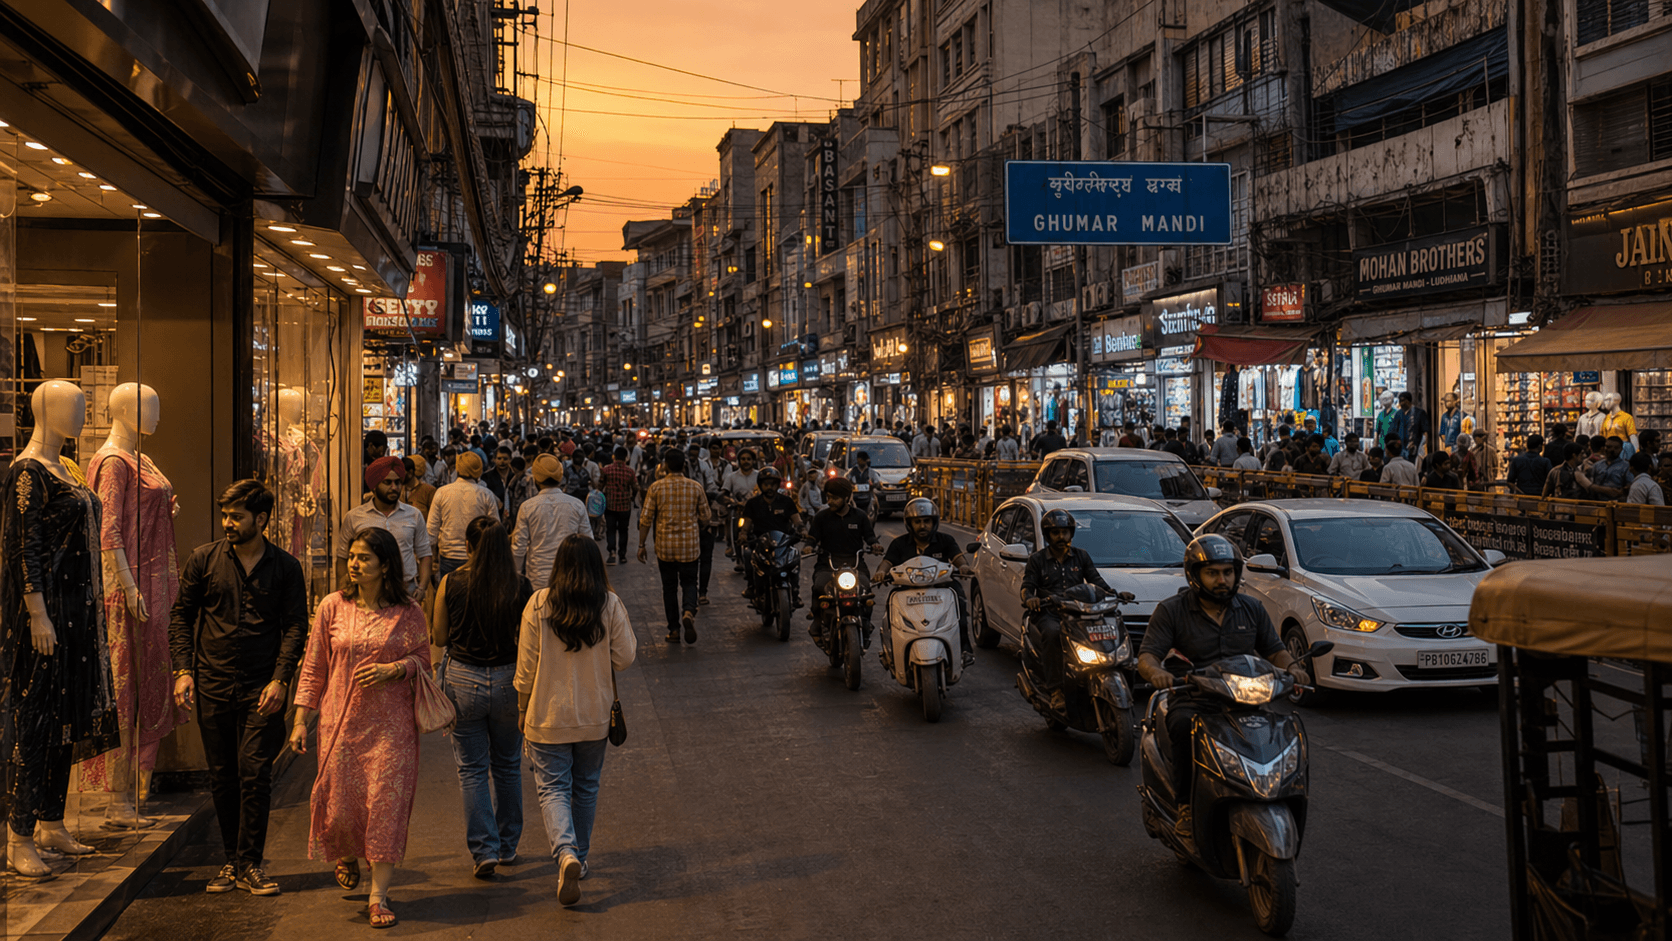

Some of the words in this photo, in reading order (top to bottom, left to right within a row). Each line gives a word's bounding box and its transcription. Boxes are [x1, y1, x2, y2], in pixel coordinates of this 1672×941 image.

[824, 150, 836, 239] BASANT
[1034, 214, 1118, 232] GHUMAR
[1141, 214, 1204, 232] MANDI
[1360, 251, 1406, 282] MOHAN
[1410, 239, 1485, 274] BROTHERS
